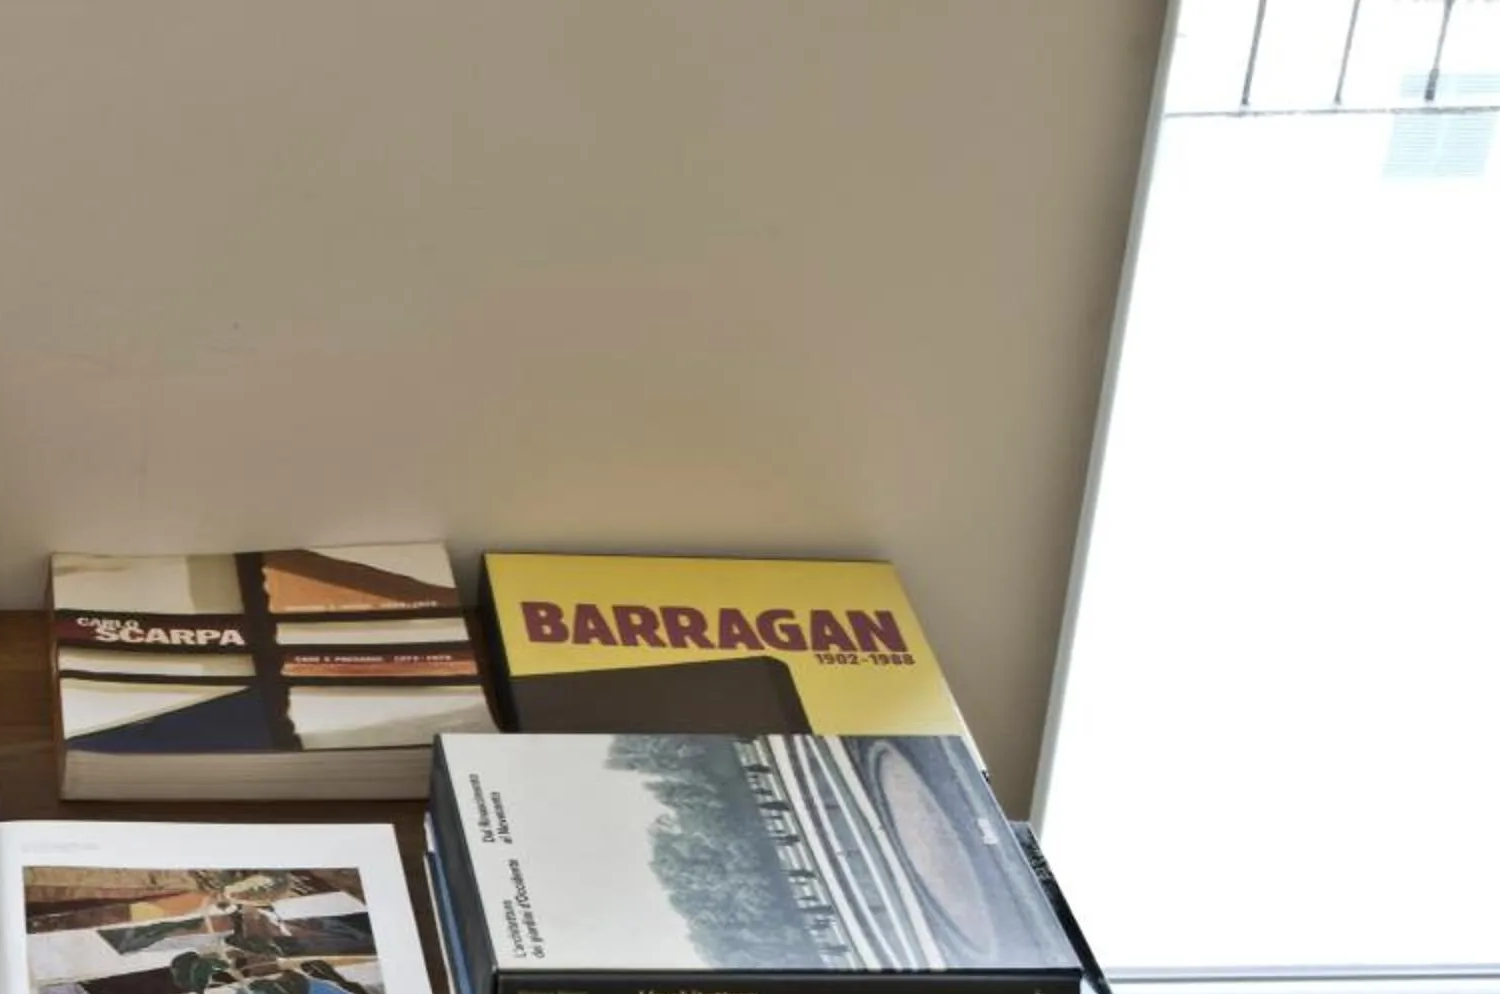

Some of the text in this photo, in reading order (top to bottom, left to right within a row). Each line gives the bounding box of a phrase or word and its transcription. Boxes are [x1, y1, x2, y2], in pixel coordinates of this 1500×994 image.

[76, 616, 139, 630] CARLO
[520, 601, 908, 652] BARRAGAN
[95, 626, 246, 647] SCARPA
[815, 652, 916, 666] 1902-1988
